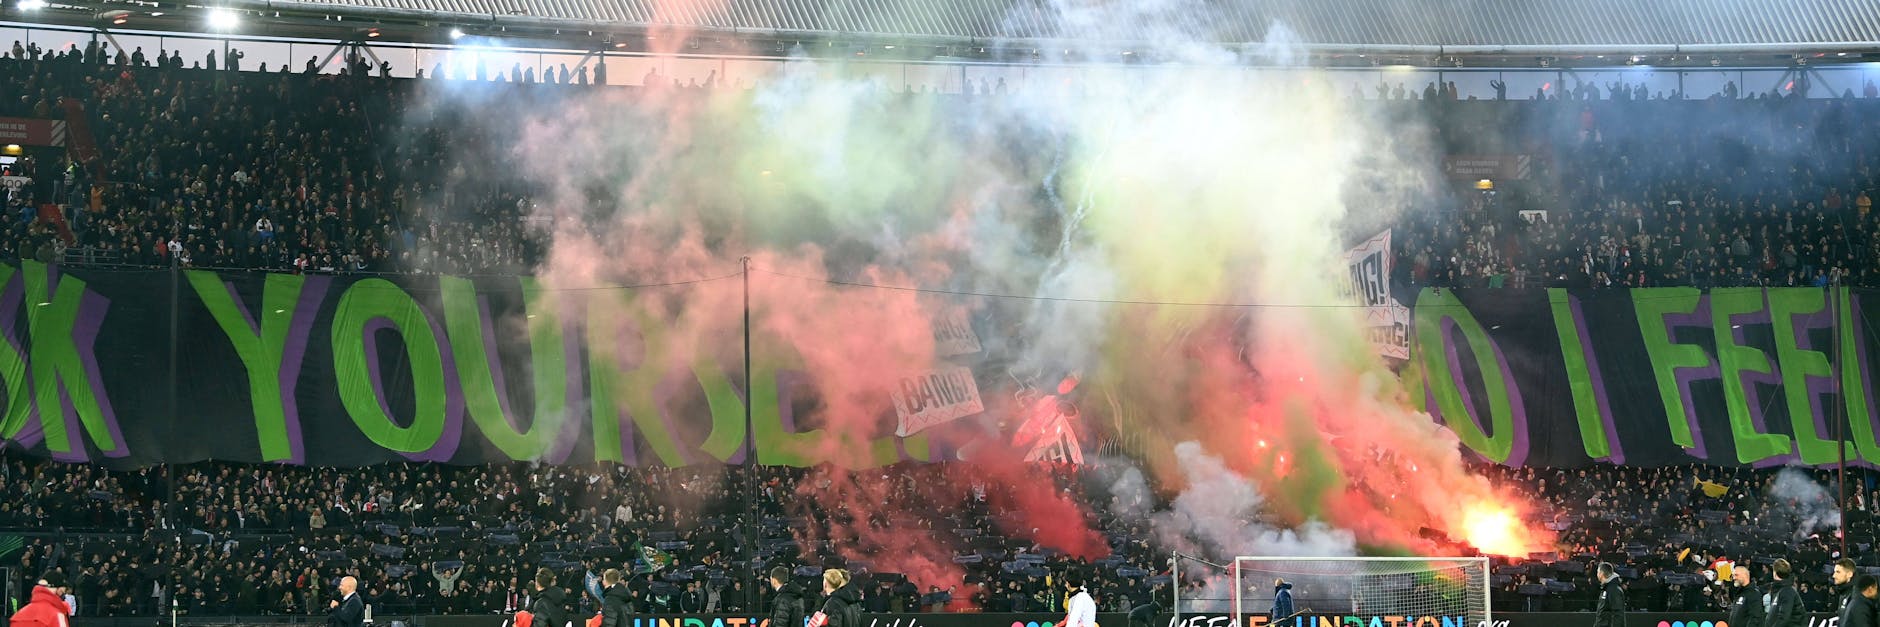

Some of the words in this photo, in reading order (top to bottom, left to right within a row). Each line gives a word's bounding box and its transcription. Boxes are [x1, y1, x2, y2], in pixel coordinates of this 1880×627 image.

[901, 372, 973, 416] BANG!
[1547, 287, 1612, 462] I
[1629, 286, 1880, 466] FEEL
